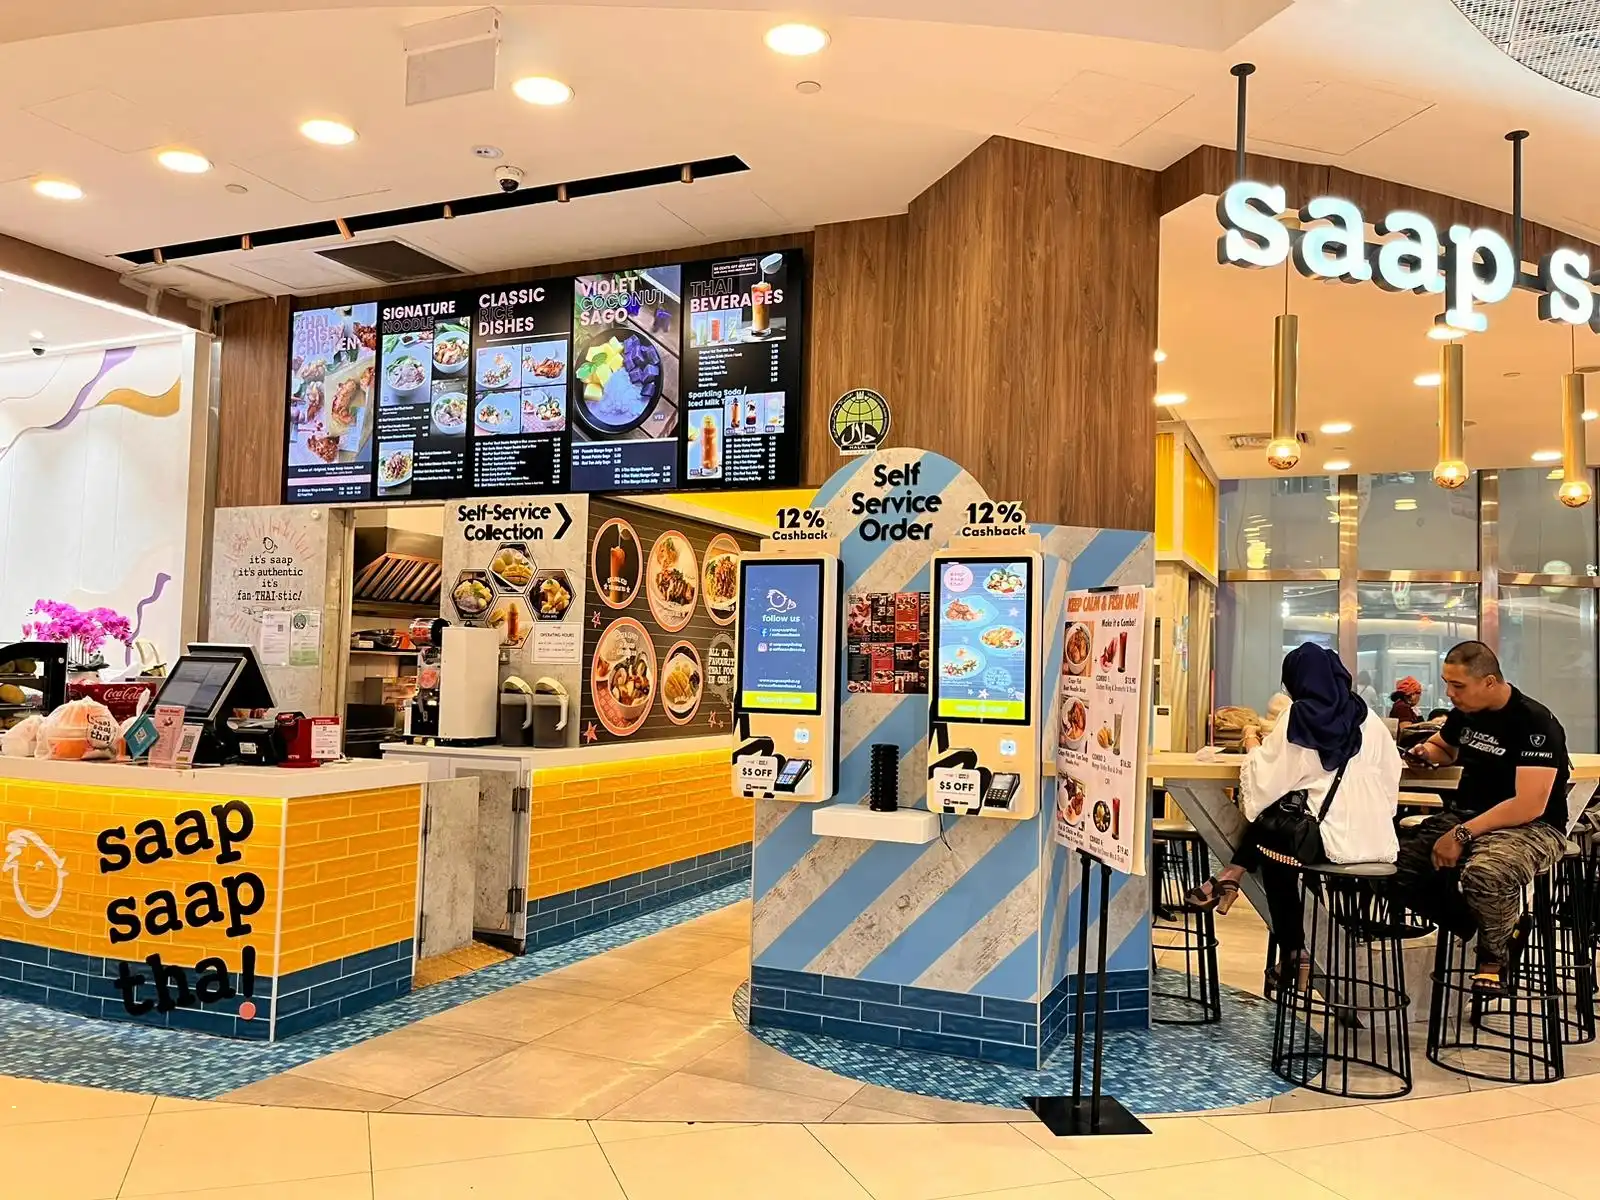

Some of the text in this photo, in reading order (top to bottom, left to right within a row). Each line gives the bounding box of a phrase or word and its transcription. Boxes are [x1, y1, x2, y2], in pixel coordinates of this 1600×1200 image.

[1217, 180, 1515, 332] saap
[581, 277, 638, 296] VIOLET
[690, 278, 733, 297] THAI
[479, 288, 545, 308] CLASSIC
[580, 289, 664, 310] COCONUT
[690, 289, 784, 312] BEVERAGES
[383, 301, 456, 320] SIGNATURE
[478, 305, 514, 323] RICE
[580, 308, 628, 326] SAGO
[296, 314, 328, 328] THAI
[382, 316, 434, 334] NOODLE
[478, 317, 534, 336] DISHES
[296, 325, 344, 342] CRISPY
[688, 389, 722, 400] Sparkling
[688, 400, 704, 408] Iced
[704, 398, 720, 406] Milk
[874, 461, 921, 488] Self
[852, 490, 942, 515] Service
[458, 503, 551, 522] Self-Service
[776, 508, 825, 529] 12%
[966, 502, 1022, 524] 12%
[464, 524, 543, 541] Collection
[772, 529, 828, 540] Cashback
[860, 518, 933, 542] Order
[962, 525, 1026, 537] Cashback
[250, 555, 293, 566] it's saap
[239, 568, 303, 576] it's authentic
[262, 579, 278, 587] it's
[1067, 598, 1083, 612] KEEP
[1083, 596, 1100, 612] CALM
[1108, 594, 1124, 610] FISH
[1125, 592, 1140, 610] ON!
[1102, 619, 1112, 627] Make
[1120, 618, 1136, 626] Combo!
[709, 657, 734, 666] FAVOURIT
[104, 686, 144, 701] Coca-Col
[1474, 731, 1499, 745] LOCAL
[1468, 740, 1506, 756] LEGEND
[742, 767, 772, 777] $5 OFF
[940, 781, 974, 792] $5 OFF
[96, 800, 254, 874] saap
[106, 872, 265, 944] saap
[113, 945, 256, 1020] tha!
